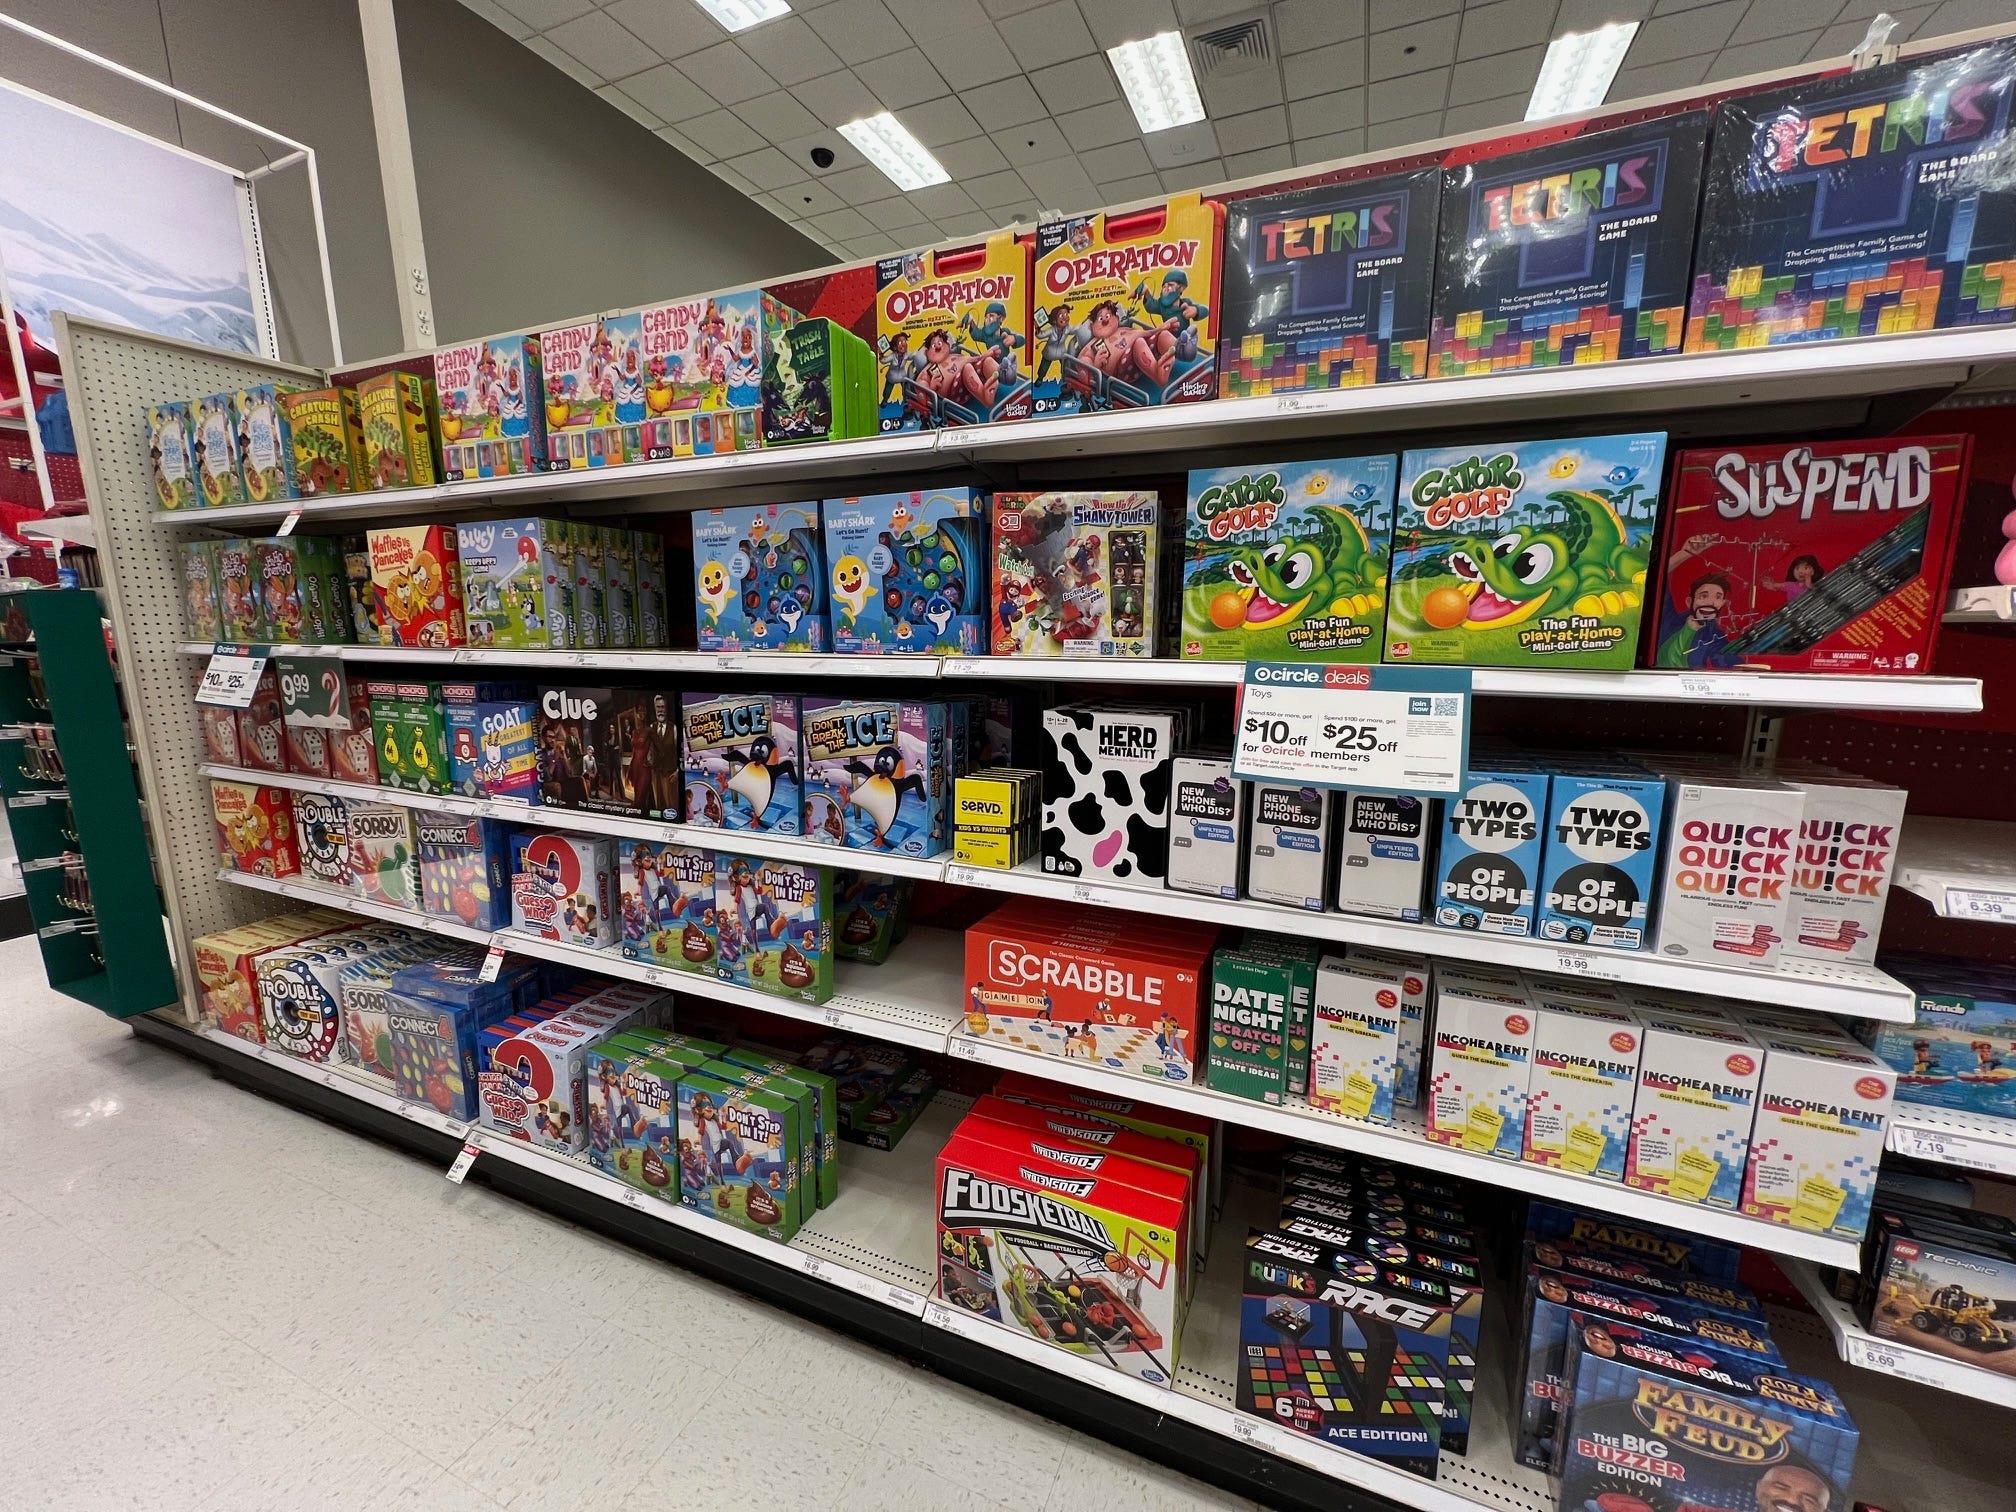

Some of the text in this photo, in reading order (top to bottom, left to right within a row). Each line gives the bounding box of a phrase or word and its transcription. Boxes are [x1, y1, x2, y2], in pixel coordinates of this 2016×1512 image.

[1921, 151, 1997, 172] THE BOARD
[1262, 205, 1395, 262] TETRIS
[1356, 268, 1379, 278] GAME
[885, 276, 1014, 323] OPERATION
[792, 330, 822, 350] TRASH
[436, 346, 479, 372] CANDY
[796, 347, 825, 365] TABLE
[438, 370, 470, 391] LAND
[1183, 388, 1206, 396] GAMES
[290, 400, 339, 419] CREATURE
[305, 413, 339, 427] CRASH
[1714, 446, 1930, 519] SUSPEND
[998, 501, 1026, 510] MARIO
[1198, 473, 1283, 520] GATOR
[1073, 505, 1154, 527] SHAKY TOWER
[1210, 503, 1275, 538] GOLF
[696, 526, 737, 537] BABY SHARK
[372, 548, 413, 573] Pancakes
[1063, 586, 1085, 599] Exciting
[1305, 618, 1350, 630] The Fun
[1290, 626, 1370, 642] Play-at-Home
[1532, 639, 1612, 652] Mini-Golf Game
[1832, 652, 1869, 661] WARNING:
[206, 672, 220, 686] $10
[228, 674, 242, 688] $25
[1324, 667, 1369, 685] deals
[398, 686, 428, 696] MONOPOLY
[1250, 688, 1272, 699] Toys
[542, 690, 597, 721] Clue
[1411, 700, 1427, 708] join
[483, 707, 520, 734] GOAT
[722, 703, 768, 735] ICE
[814, 717, 843, 733] DON'T
[500, 728, 525, 741] GREATEST
[691, 721, 723, 736] BREAK
[704, 730, 722, 743] THE
[1099, 724, 1157, 749] HERD
[1245, 718, 1308, 746] $10 off
[1323, 723, 1378, 751] $25
[1378, 742, 1398, 753] off
[1099, 746, 1157, 760] MENTALITY
[1243, 742, 1370, 763] for circle members
[516, 759, 528, 767] TIME
[1181, 786, 1204, 797] NEW
[1181, 795, 1216, 806] PHONE
[294, 805, 346, 824] TROUBLE
[1181, 803, 1231, 816] WHO DIS?
[1462, 800, 1527, 820] TWO
[353, 815, 406, 838] SORRY!
[421, 819, 480, 852] CONNECT 4
[981, 826, 1007, 834] PARENTS
[1449, 817, 1537, 840] TYPES
[1281, 834, 1316, 844] UNFILTERED
[666, 853, 715, 873] DON'T STEP
[1472, 867, 1506, 885] OF
[1441, 881, 1534, 906] PEOPLE
[1970, 902, 2002, 913] 6.39
[1558, 958, 1588, 970] 19.99
[999, 950, 1164, 1005] SCRABBLE
[984, 992, 1044, 1005] GAME ON
[1214, 982, 1284, 1013] DATE
[1317, 1004, 1397, 1028] INCOHEARENT
[1920, 1000, 1966, 1015] Friends
[824, 1015, 839, 1023] 16.99
[1214, 1003, 1282, 1031] NIGHT
[1213, 1022, 1281, 1045] SCRATCH
[958, 1047, 975, 1055] 11.49
[1232, 1040, 1260, 1054] OFF
[1223, 1061, 1246, 1072] DATE
[1249, 1067, 1279, 1079] IDEAS!
[1659, 1093, 1679, 1102] GUESS
[1693, 1099, 1728, 1111] GIBBERISH
[740, 1122, 769, 1142] IN IT!
[1914, 1139, 1944, 1153] 7.19
[944, 1170, 1118, 1250] FOOSKETBALL
[1895, 1245, 1999, 1276] LEGO TECHNIC
[1250, 1260, 1316, 1295] RUBIK'S
[1318, 1279, 1438, 1329] RACE
[1867, 1351, 1895, 1367] 6.69
[1275, 1397, 1294, 1418] 6
[1295, 1407, 1315, 1415] ADDED
[1635, 1377, 1794, 1447] FAMILY
[1328, 1428, 1428, 1443] ACE EDITION!
[1653, 1407, 1767, 1461] FEUD
[1592, 1431, 1669, 1458] THE BIG
[1577, 1439, 1686, 1482] BUZZER
[1597, 1461, 1663, 1488] EDITION
